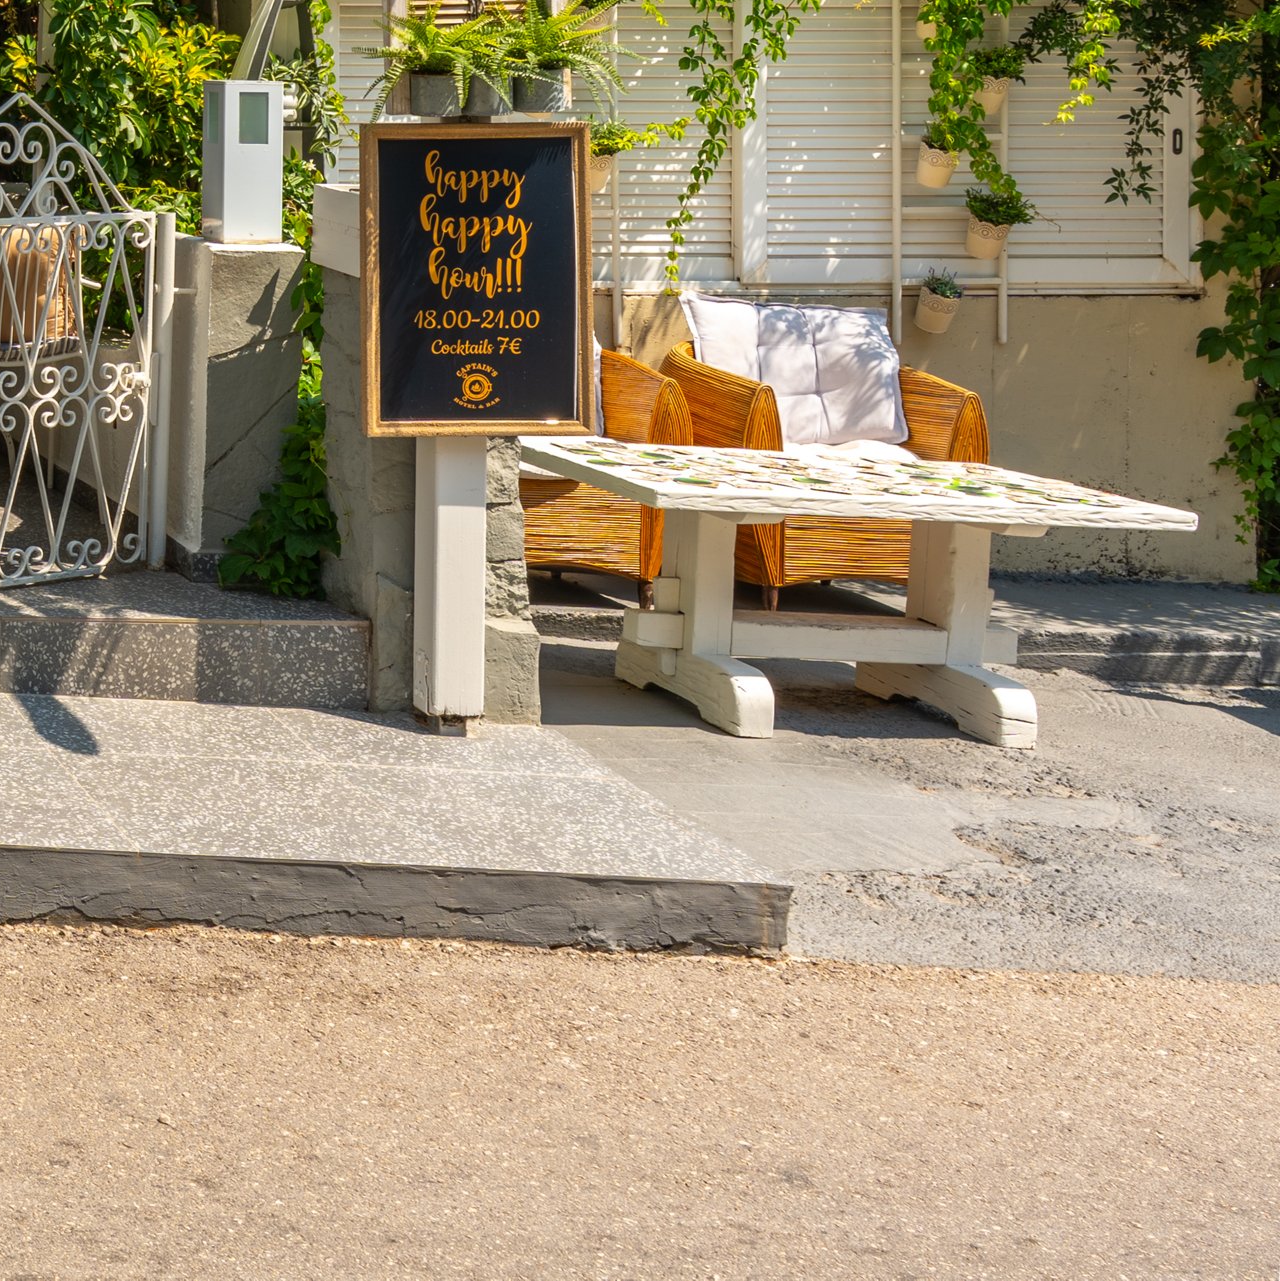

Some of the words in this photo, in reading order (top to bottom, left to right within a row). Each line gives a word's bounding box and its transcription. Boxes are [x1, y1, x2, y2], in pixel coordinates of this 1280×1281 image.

[424, 149, 526, 209] happy
[419, 193, 533, 259] happy
[428, 246, 523, 300] hour!!!
[414, 309, 541, 329] 18.00-21.00
[430, 338, 495, 356] Cocktails
[496, 336, 523, 355] 7€
